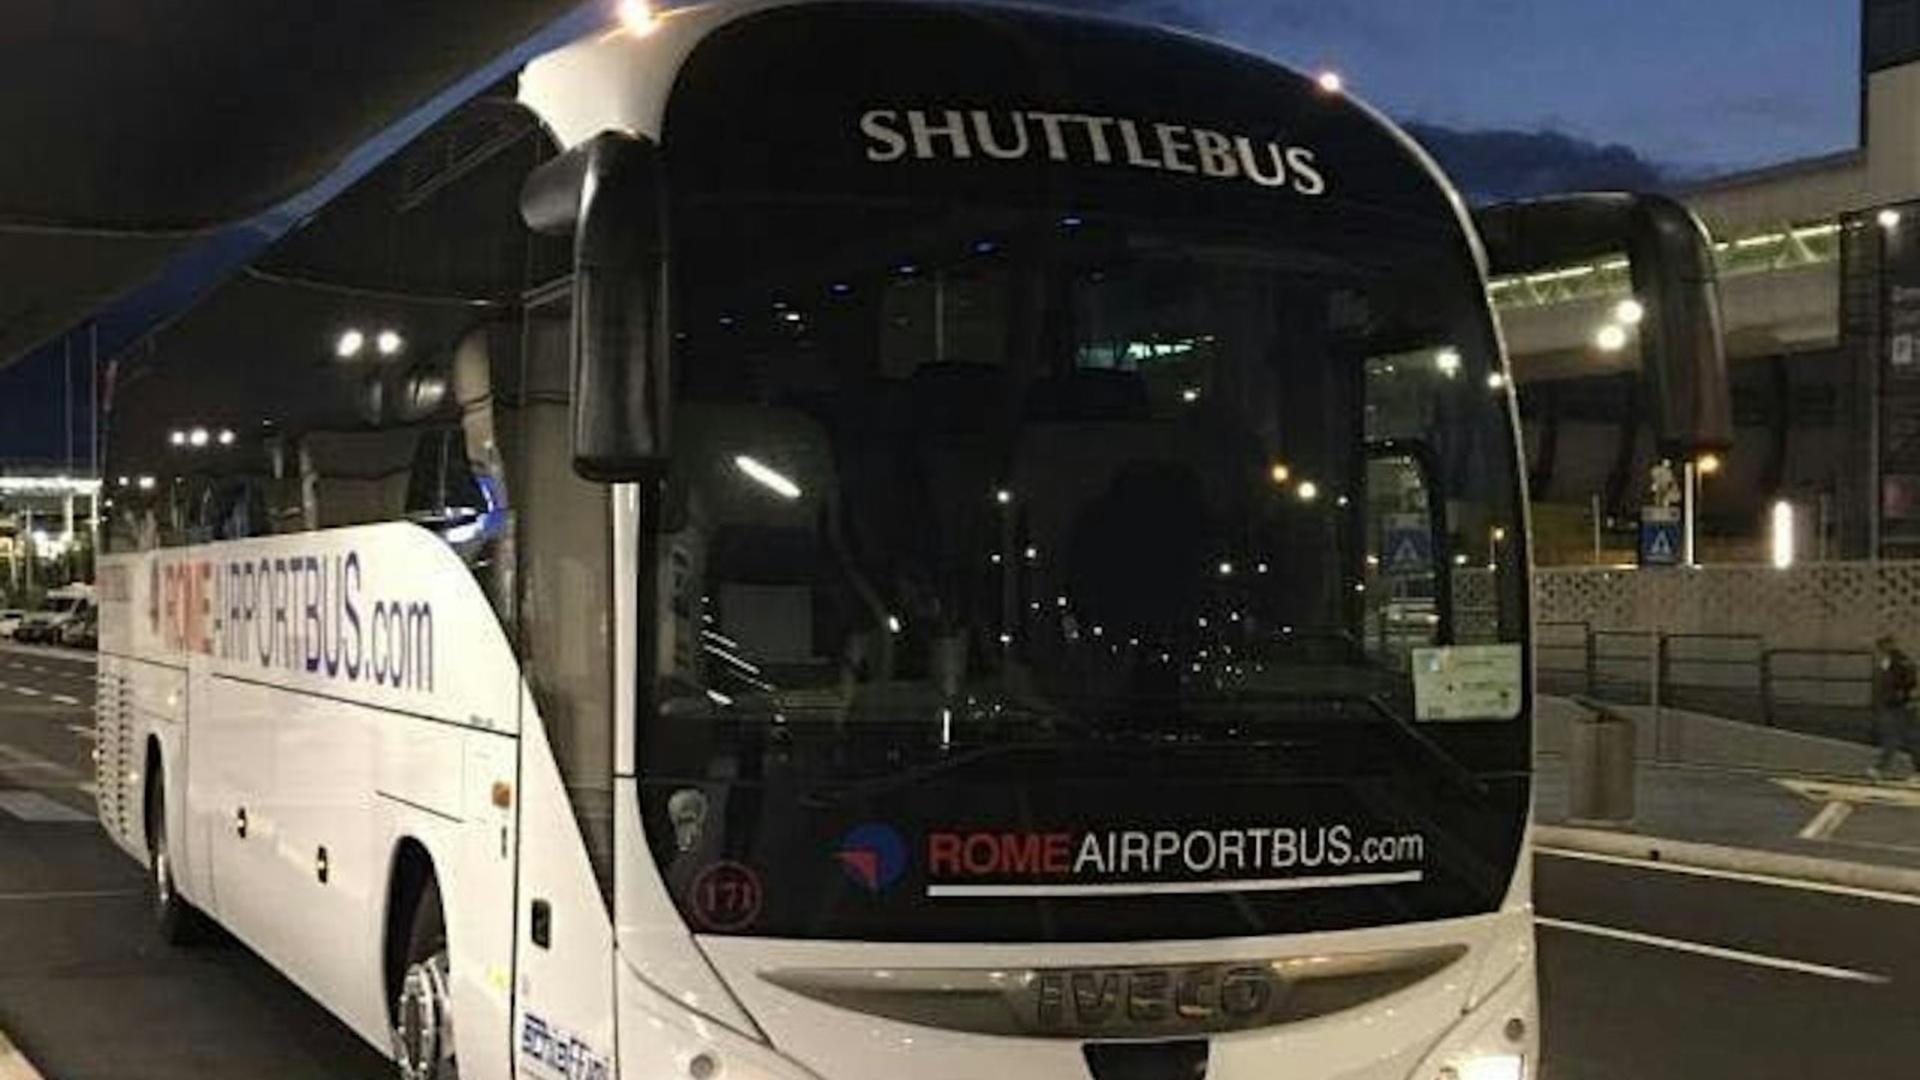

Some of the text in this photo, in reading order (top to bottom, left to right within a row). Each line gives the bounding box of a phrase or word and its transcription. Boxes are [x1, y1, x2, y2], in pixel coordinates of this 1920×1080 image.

[860, 108, 1325, 196] SHUTTLEBUS
[928, 825, 1425, 877] ROMEAIRPORTBUS.com
[1035, 966, 1274, 1025] IVECO
